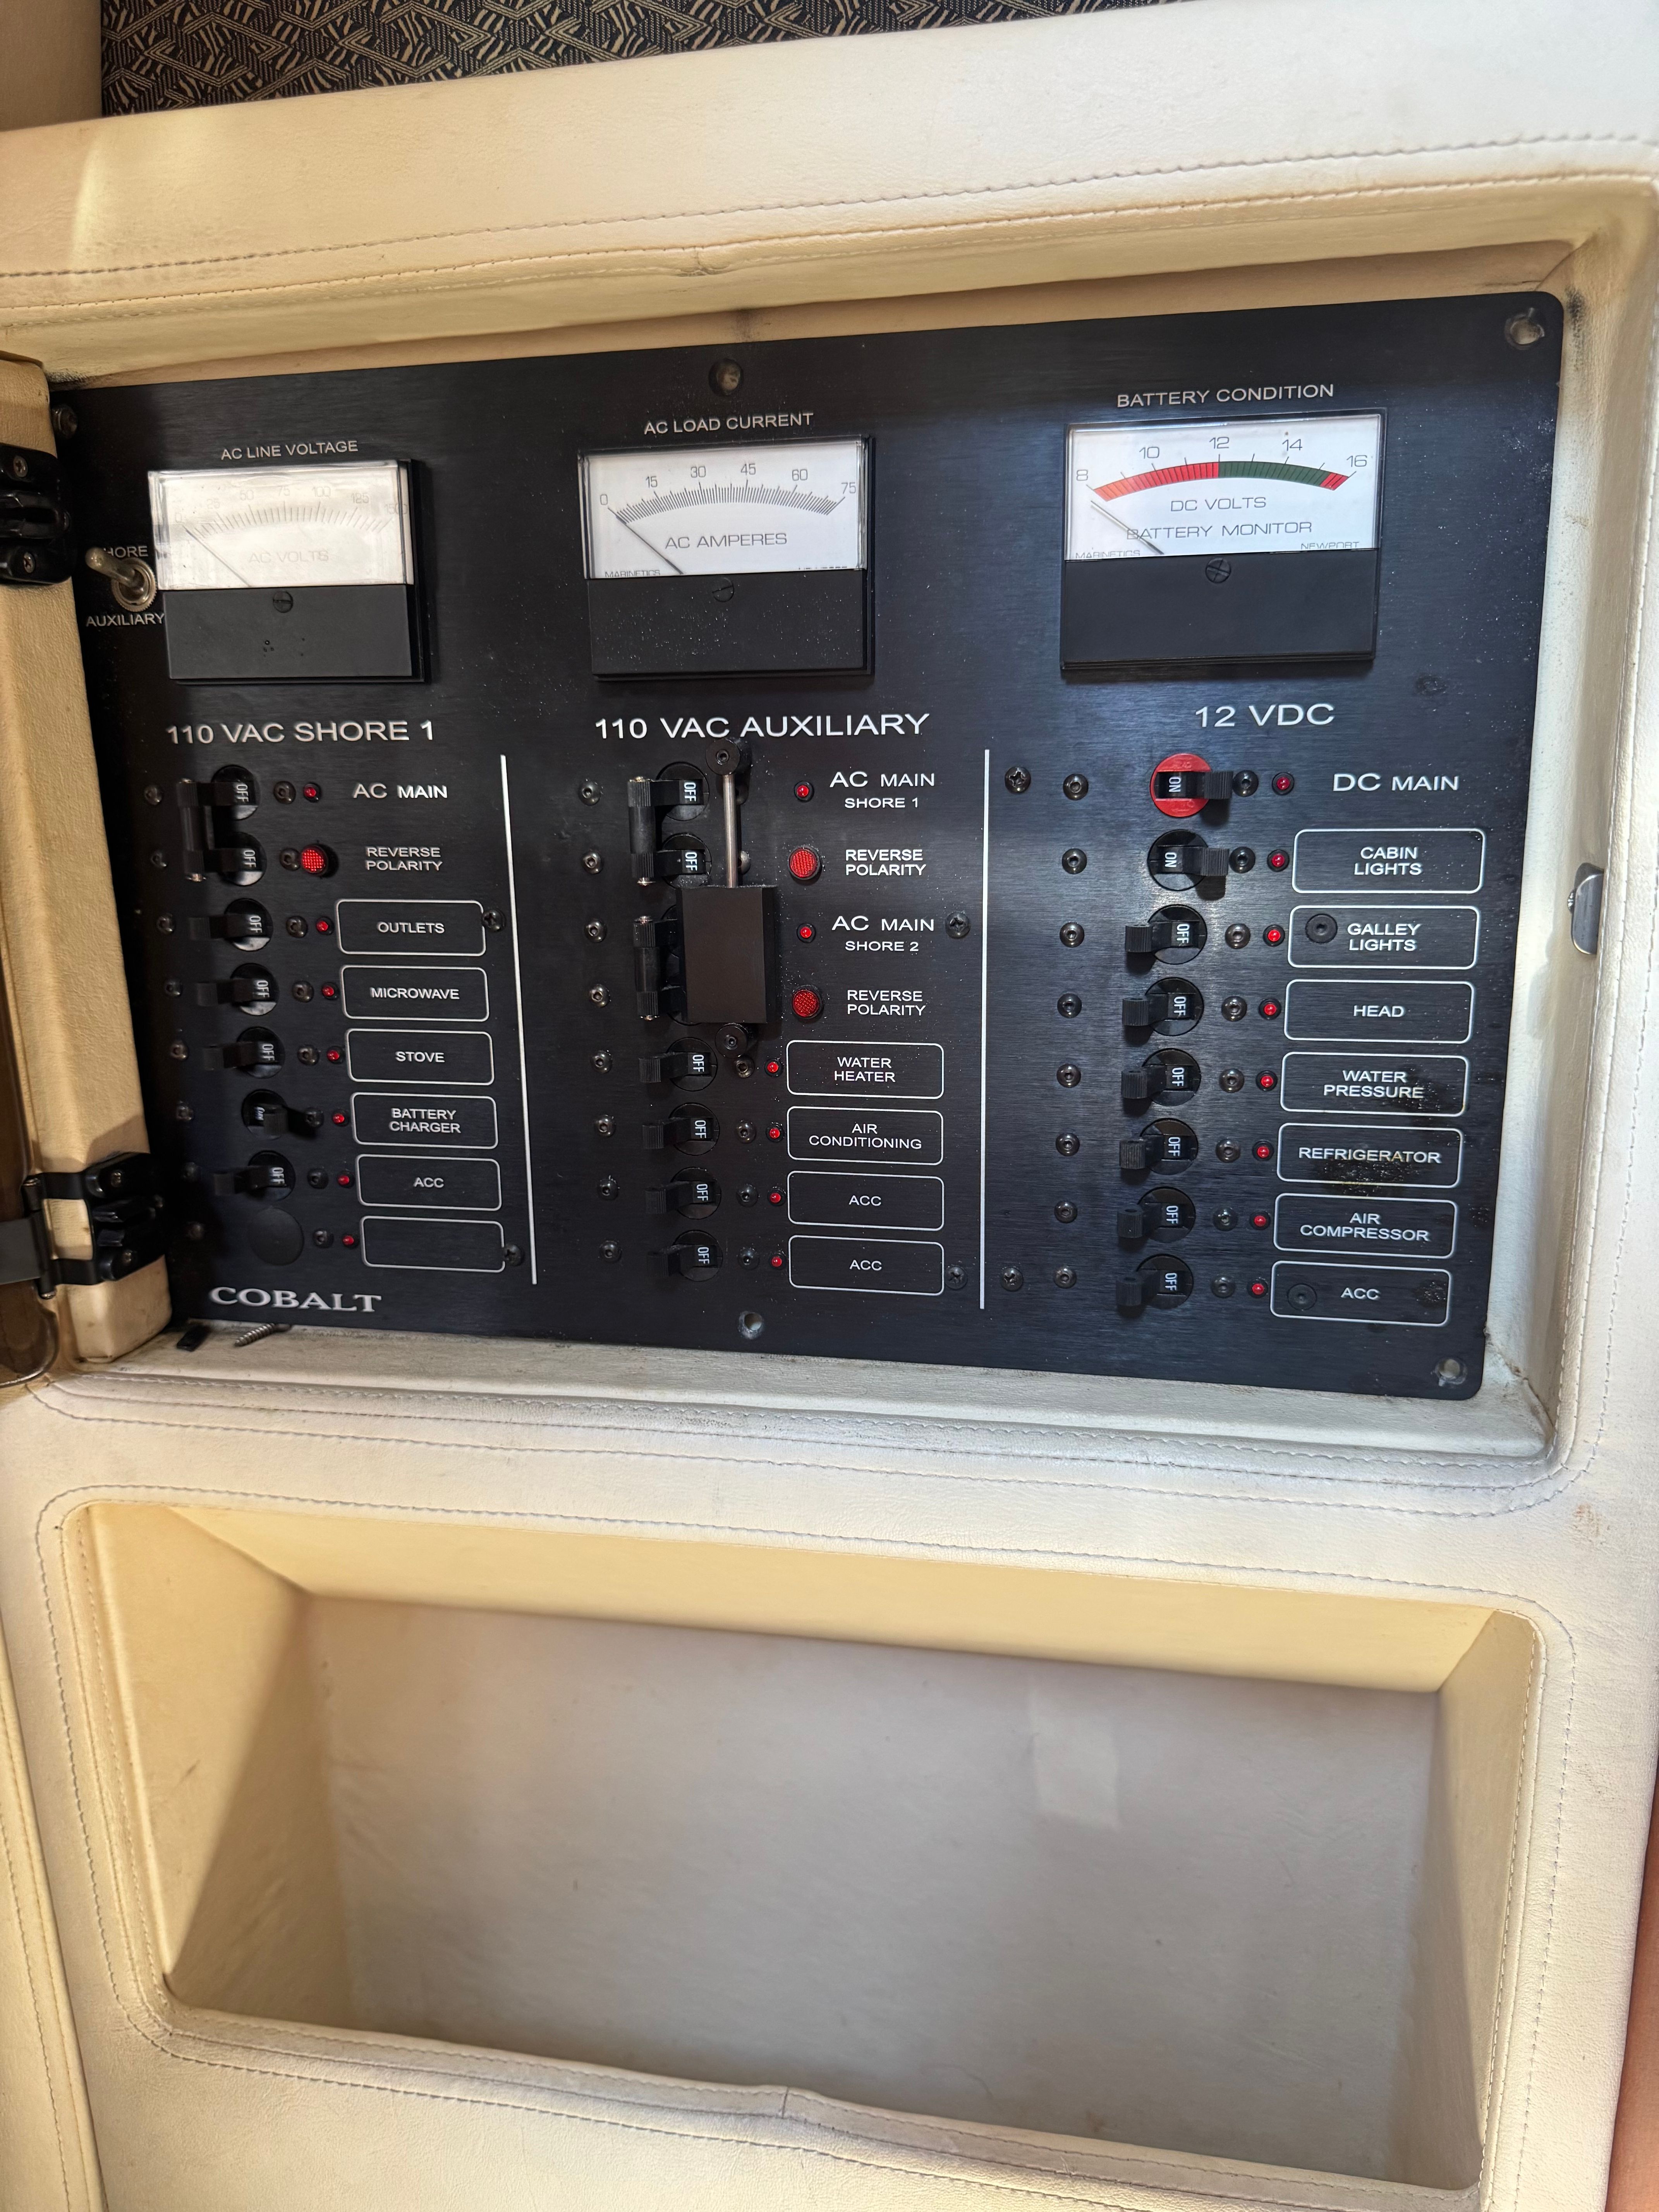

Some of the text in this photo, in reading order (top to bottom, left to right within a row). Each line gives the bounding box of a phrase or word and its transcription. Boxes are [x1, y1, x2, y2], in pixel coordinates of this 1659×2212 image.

[1117, 384, 1333, 407] BATTERY CONDITION
[644, 412, 814, 434] AC LOAD CURRENT
[1209, 436, 1230, 449] 12
[1282, 438, 1303, 452] 14
[221, 440, 358, 460] AC LINE VOLTAGE
[1139, 446, 1160, 459] 10
[1346, 455, 1367, 467] 16
[690, 465, 706, 478] 30
[740, 463, 756, 475] 45
[792, 469, 808, 481] 60
[1076, 469, 1088, 481] 8
[646, 476, 658, 488] 15
[841, 482, 856, 494] 75
[599, 493, 608, 505] 0
[1171, 497, 1266, 512] DC VOLTS
[1127, 522, 1312, 539] BATTERY MONITOR
[665, 533, 787, 549] AC AMPERES
[103, 546, 148, 558] HORE
[86, 613, 164, 627] AUXILIARY
[1195, 703, 1334, 727] 12 VDC
[168, 720, 433, 744] 110 VAC SHORE 1
[596, 713, 930, 739] 110 VAC AUXILIARY
[830, 771, 934, 788] AC MAIN
[1168, 776, 1182, 792] ON
[1333, 773, 1458, 791] DC MAIN
[235, 783, 249, 802] OFF
[353, 783, 447, 799] AC MAIN
[684, 782, 696, 802] OFF
[845, 797, 918, 809] SHORE 1
[243, 849, 256, 867] OFF
[367, 847, 441, 857] REVERSE
[846, 849, 923, 861] REVERSE
[1360, 847, 1417, 859] CABIN
[366, 860, 443, 871] POLARITY
[685, 852, 697, 871] OFF
[1164, 852, 1177, 867] ON
[846, 864, 926, 876] POLARITY
[1354, 863, 1422, 875] LIGHTS
[249, 915, 262, 933] OFF
[378, 922, 445, 934] OUTLETS
[831, 915, 934, 931] AC MAIN
[1347, 923, 1421, 936] GALLEY
[1176, 924, 1190, 943] OFF
[845, 941, 919, 951] SHORE 2
[1349, 939, 1416, 951] LIGHTS
[256, 980, 270, 998] OFF
[371, 988, 460, 1000] MICROWAVE
[847, 990, 923, 1001] REVERSE
[847, 1004, 926, 1016] POLARITY
[1173, 996, 1186, 1017] OFF
[1353, 1005, 1404, 1017] HEAD
[261, 1043, 275, 1061] OFF
[396, 1051, 445, 1063] STOVE
[692, 1054, 704, 1072] OFF
[837, 1057, 892, 1068] WATER
[834, 1070, 896, 1082] HEATER
[1171, 1067, 1184, 1087] OFF
[1342, 1070, 1407, 1083] WATER
[1324, 1084, 1424, 1098] PRESSURE
[392, 1108, 456, 1120] BATTERY
[389, 1121, 461, 1133] CHARGER
[695, 1120, 706, 1139] OFF
[852, 1123, 878, 1134] AIR
[809, 1135, 922, 1149] CONDITIONING
[1168, 1137, 1180, 1156] OFF
[1299, 1147, 1441, 1163] REFRIGERATOR
[271, 1167, 285, 1184] OFF
[413, 1177, 444, 1188] ACC
[696, 1183, 708, 1201] OFF
[848, 1195, 881, 1206] ACC
[1166, 1206, 1178, 1224] OFF
[1349, 1212, 1380, 1224] AIR
[1300, 1224, 1429, 1242] COMPRESSOR
[697, 1247, 709, 1264] OFF
[849, 1259, 882, 1271] ACC
[1165, 1273, 1177, 1291] OFF
[211, 1287, 381, 1312] COBALT
[1341, 1287, 1379, 1300] ACC
